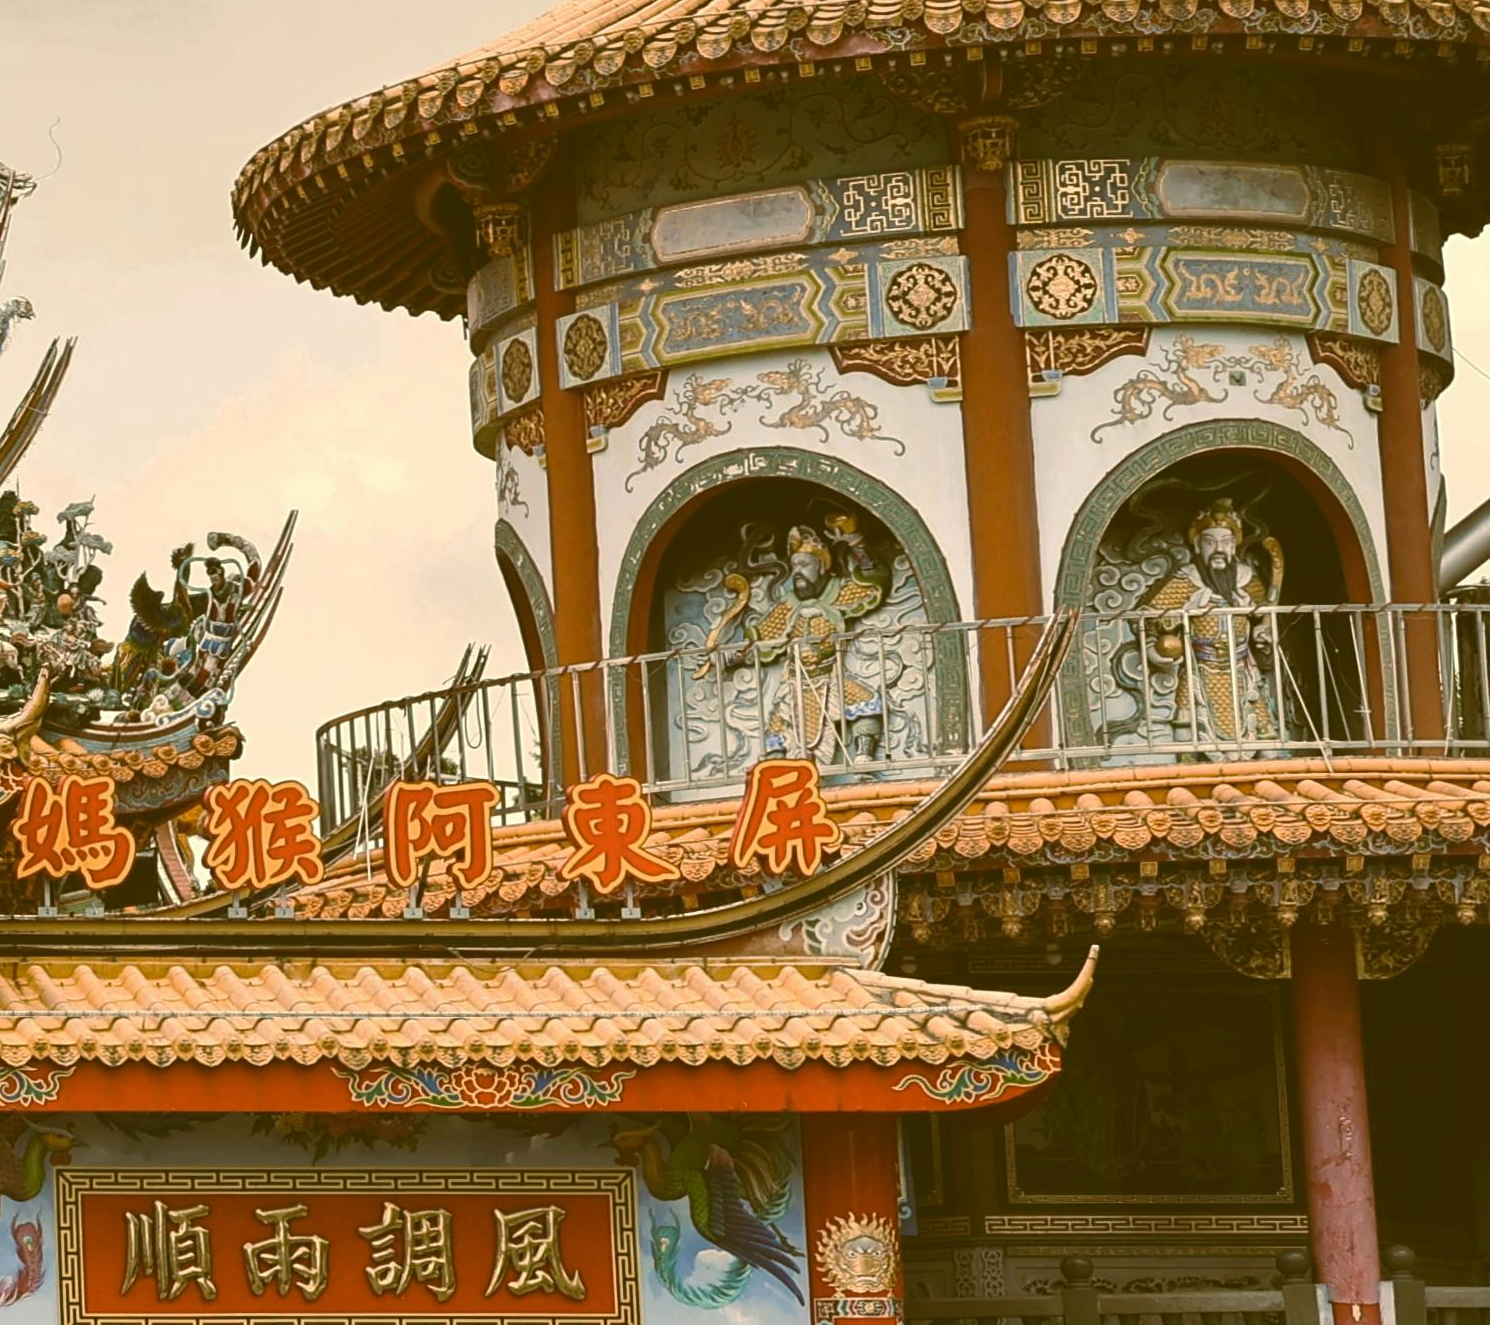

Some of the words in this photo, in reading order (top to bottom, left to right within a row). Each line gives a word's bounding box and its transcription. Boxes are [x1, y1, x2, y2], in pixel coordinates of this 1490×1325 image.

[12, 757, 843, 893] 屏東阿猴媽
[120, 1199, 587, 1302] 風調雨順
